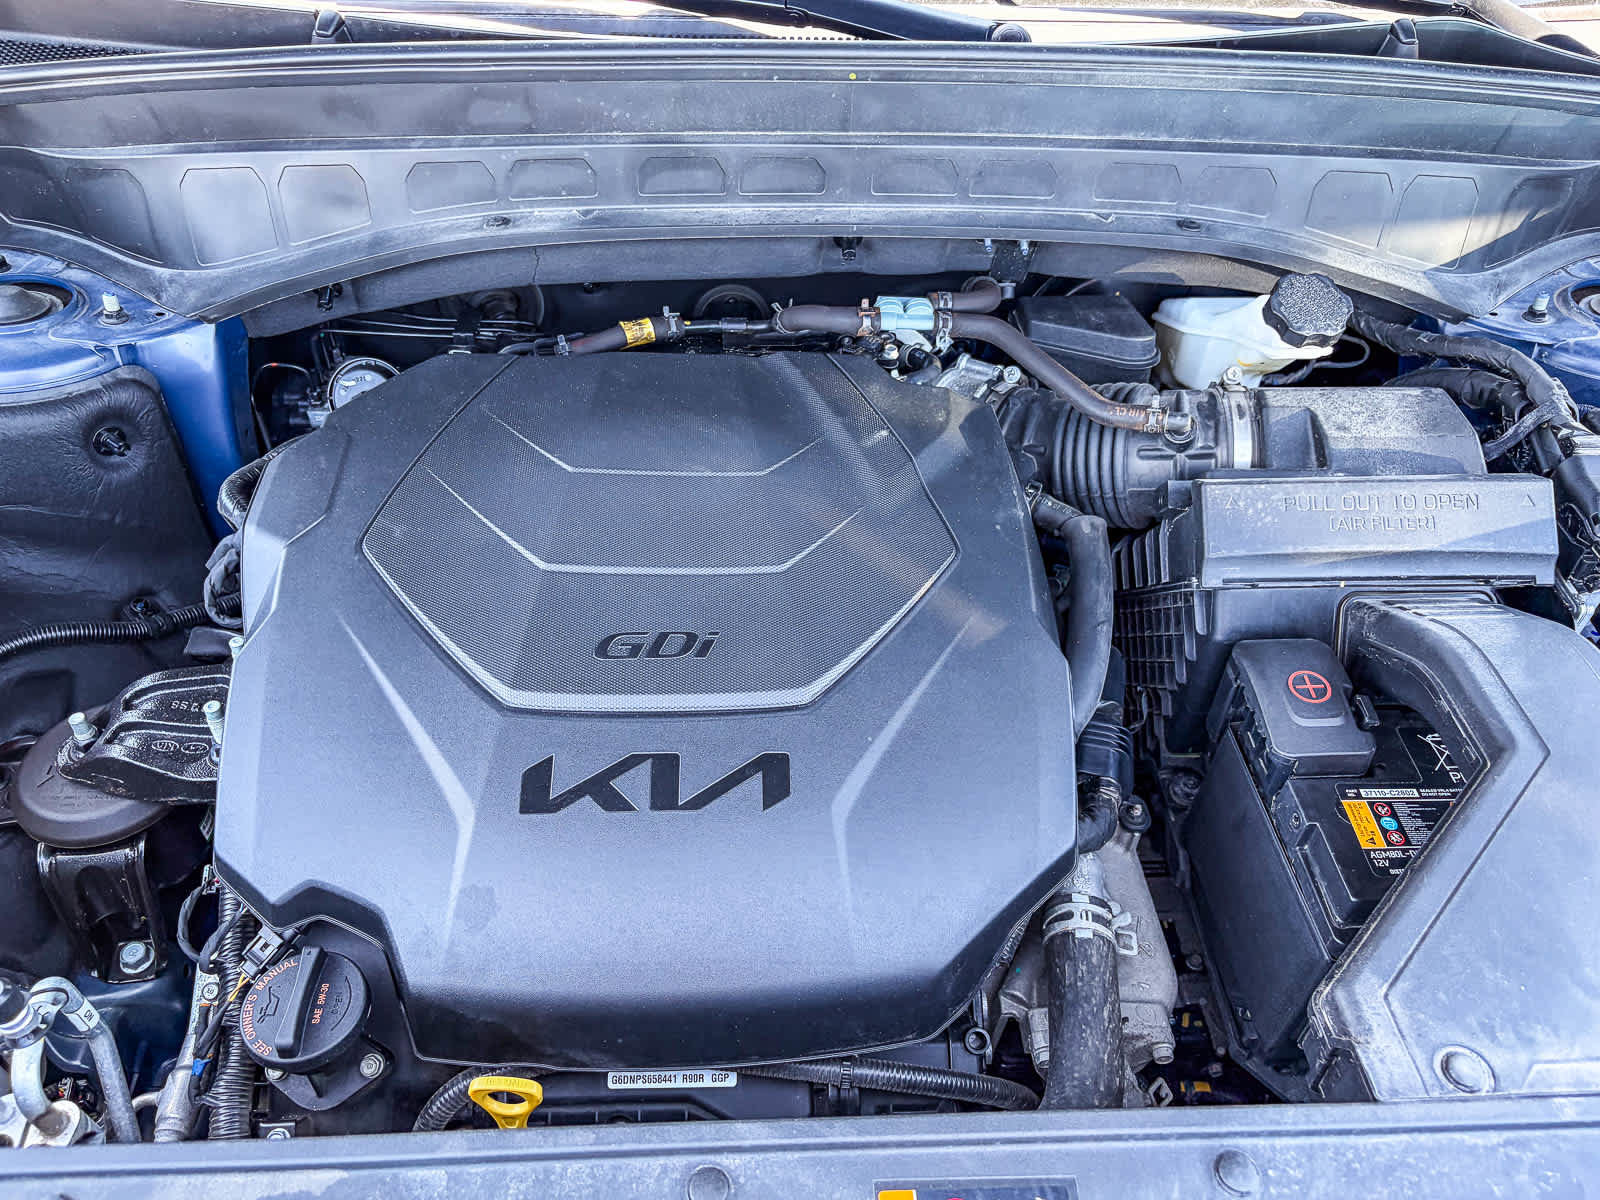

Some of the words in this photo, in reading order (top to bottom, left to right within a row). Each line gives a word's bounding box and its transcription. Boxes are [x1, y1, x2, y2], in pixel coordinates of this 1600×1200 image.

[1282, 494, 1336, 511] PULL
[1342, 494, 1381, 511] OUT
[1391, 494, 1417, 511] TO
[1423, 493, 1480, 511] OPEN
[593, 631, 721, 660] GDi
[519, 751, 791, 814] KIA
[255, 959, 299, 991] MANUAL
[242, 994, 258, 1040] OWNER'S
[311, 1008, 323, 1024] SAE
[253, 1039, 273, 1056] SEE
[711, 1072, 730, 1083] GGP
